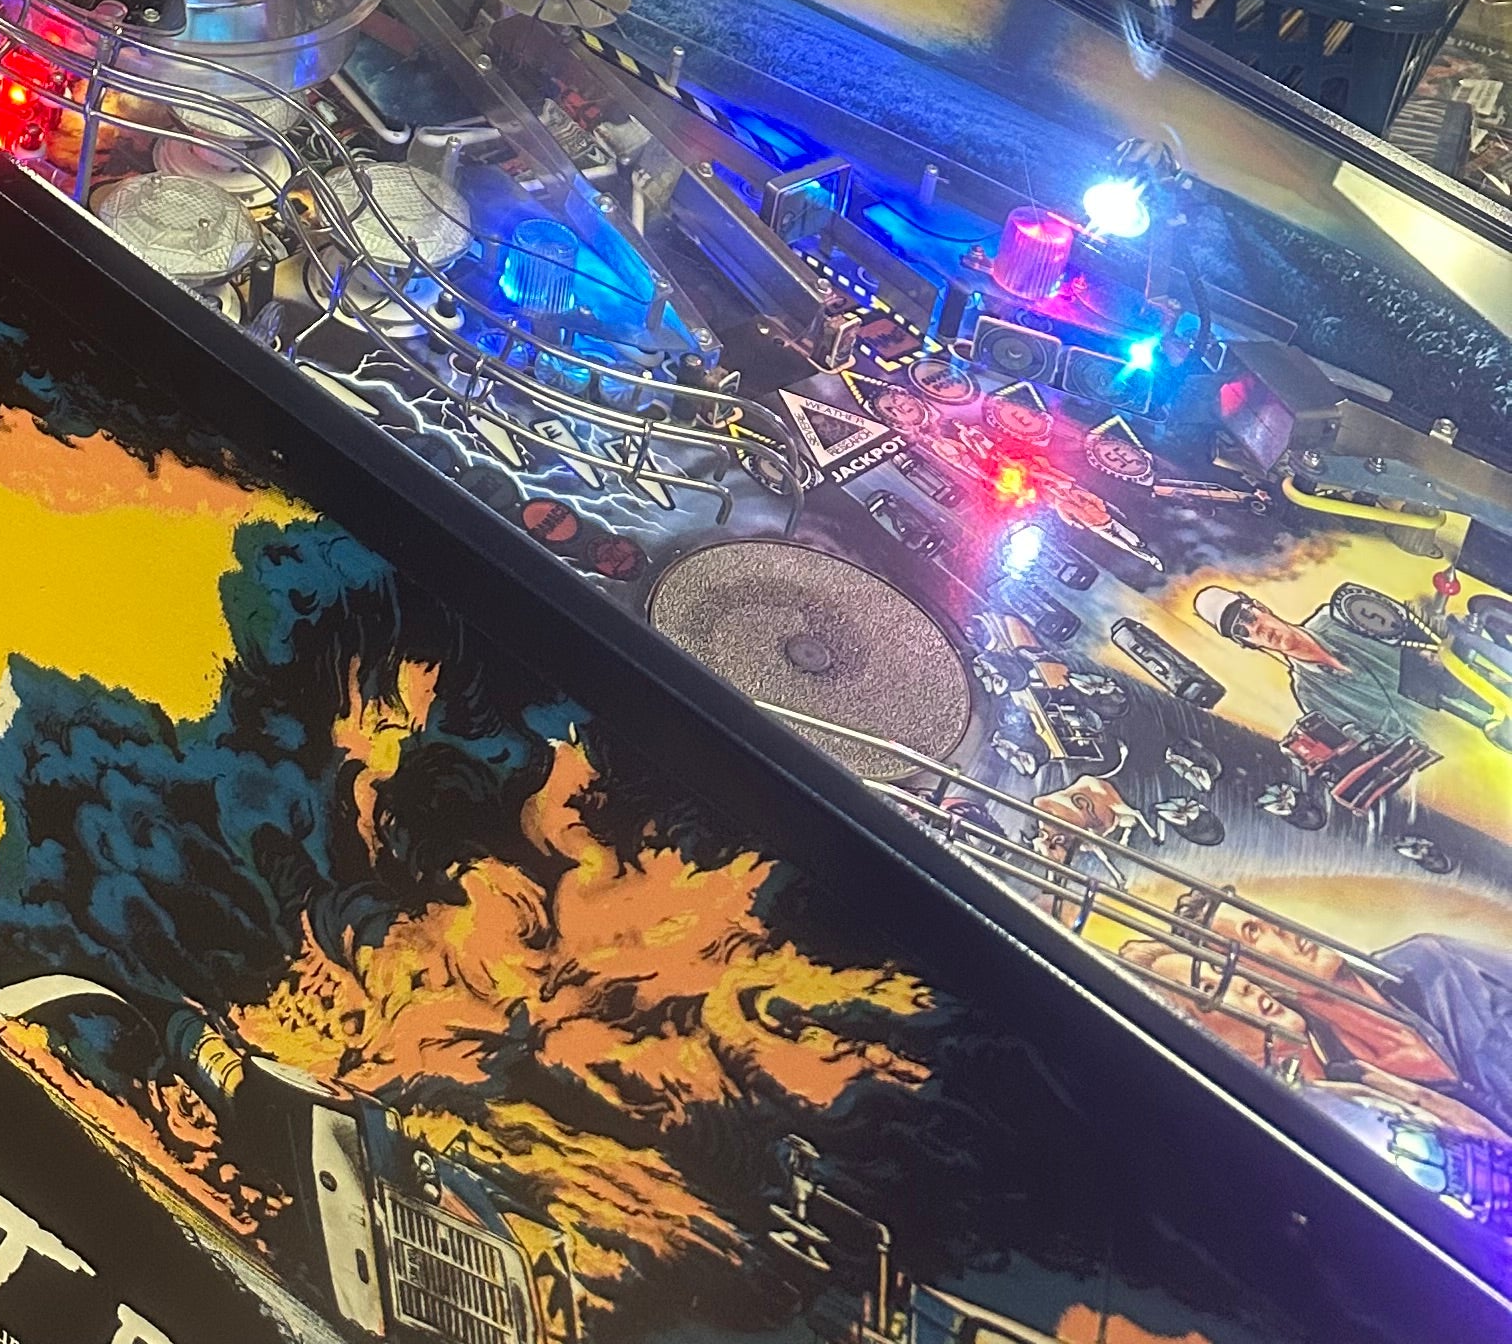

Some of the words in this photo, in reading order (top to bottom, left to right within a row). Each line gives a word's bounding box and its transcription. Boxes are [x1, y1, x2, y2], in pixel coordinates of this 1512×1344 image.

[805, 399, 865, 426] WEATHER
[827, 427, 874, 458] RESEARCH
[831, 435, 907, 483] JACKPOT
